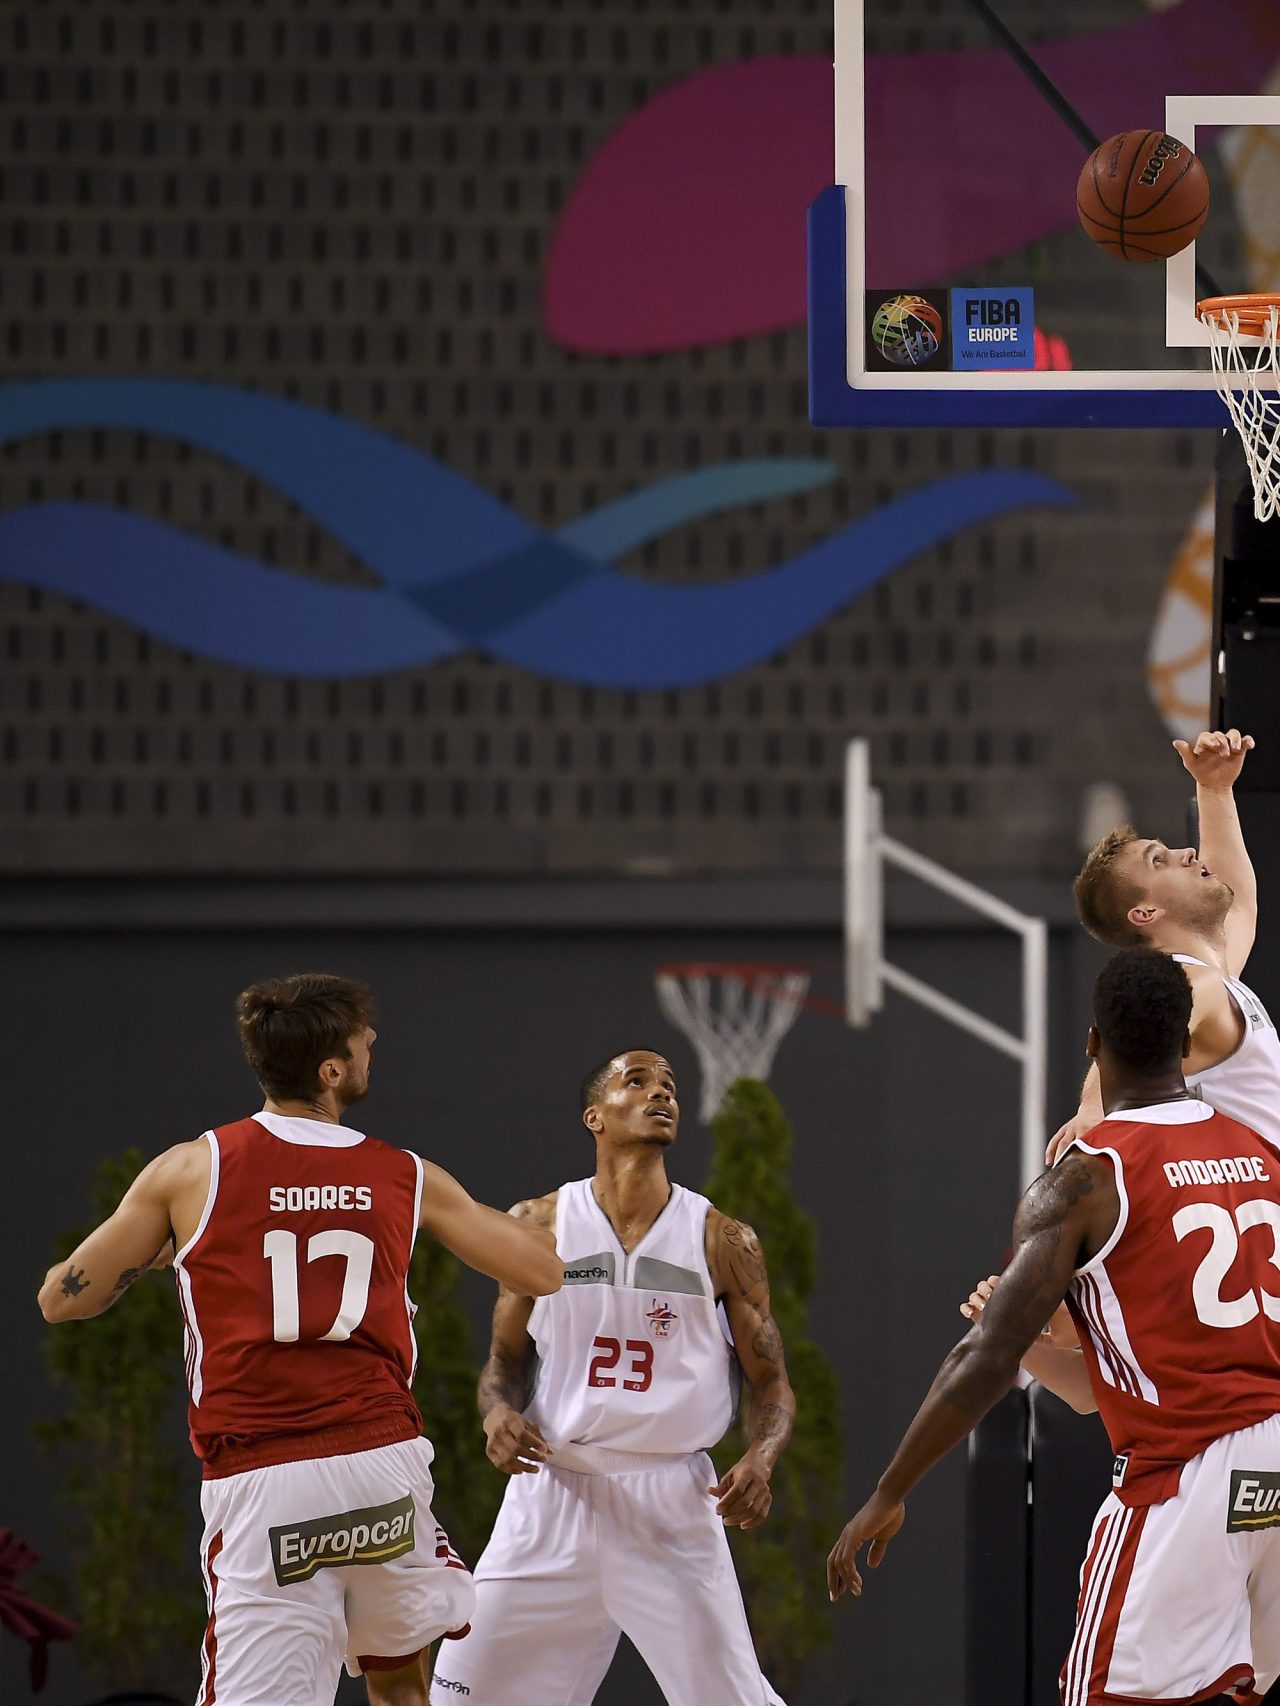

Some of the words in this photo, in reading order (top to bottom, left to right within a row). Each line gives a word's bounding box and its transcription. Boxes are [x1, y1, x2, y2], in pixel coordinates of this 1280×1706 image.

[965, 298, 1021, 326] FIBA
[968, 327, 1018, 342] EUROPE
[961, 350, 974, 358] We
[975, 350, 988, 358] Are
[990, 350, 1026, 358] Basketball
[1162, 1156, 1271, 1188] ANDRADE
[269, 1185, 372, 1212] SOARES
[263, 1229, 375, 1342] 17
[588, 1335, 654, 1393] 23
[279, 1508, 414, 1566] Europcar
